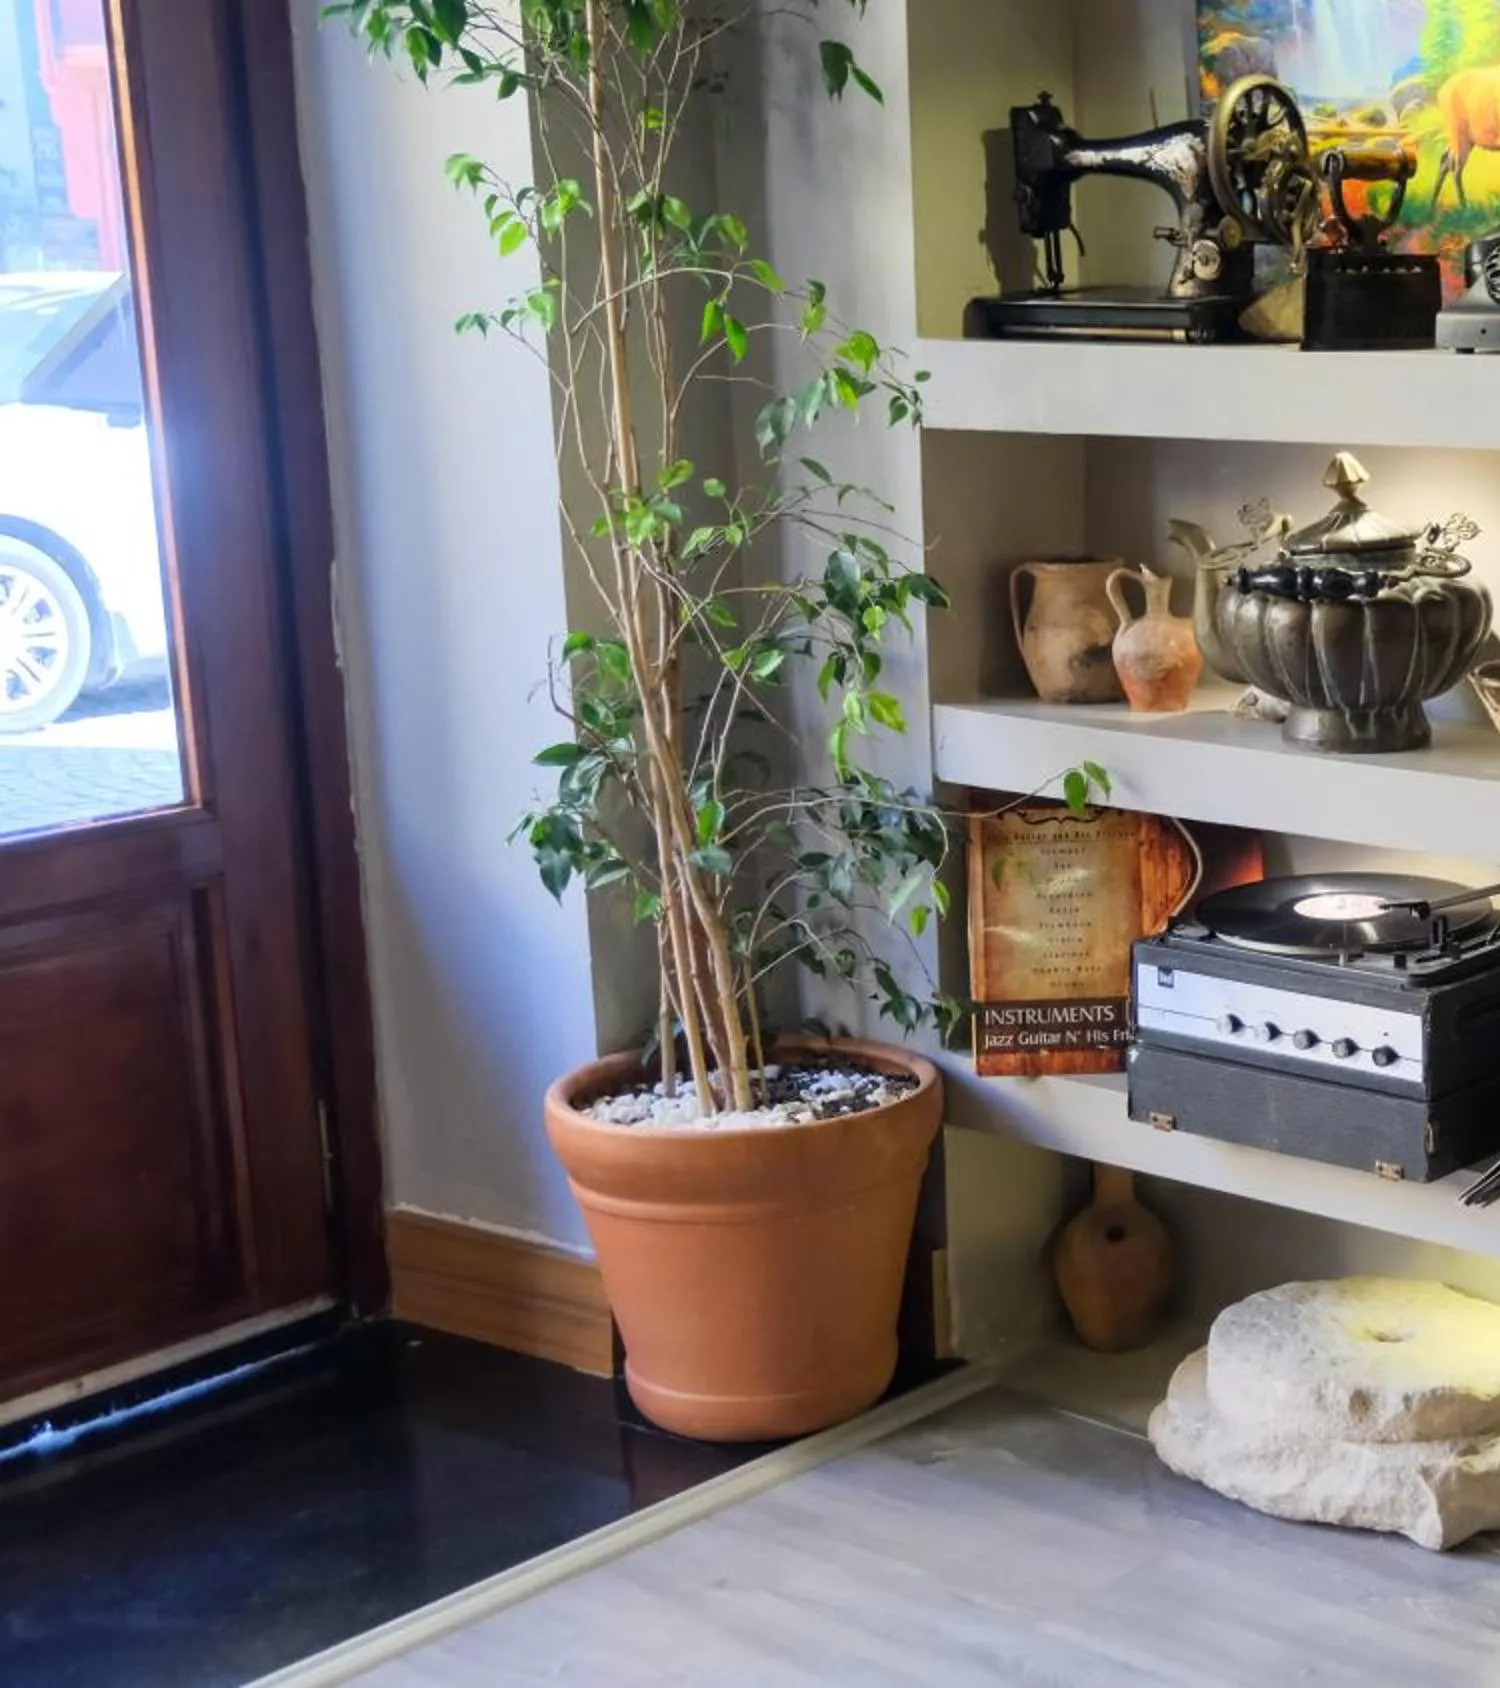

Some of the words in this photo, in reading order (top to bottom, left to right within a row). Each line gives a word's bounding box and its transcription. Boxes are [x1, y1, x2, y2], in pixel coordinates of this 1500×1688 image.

[984, 1004, 1116, 1026] INSTRUMENTS
[1017, 1030, 1062, 1046] Guitar
[1086, 1028, 1110, 1043] His
